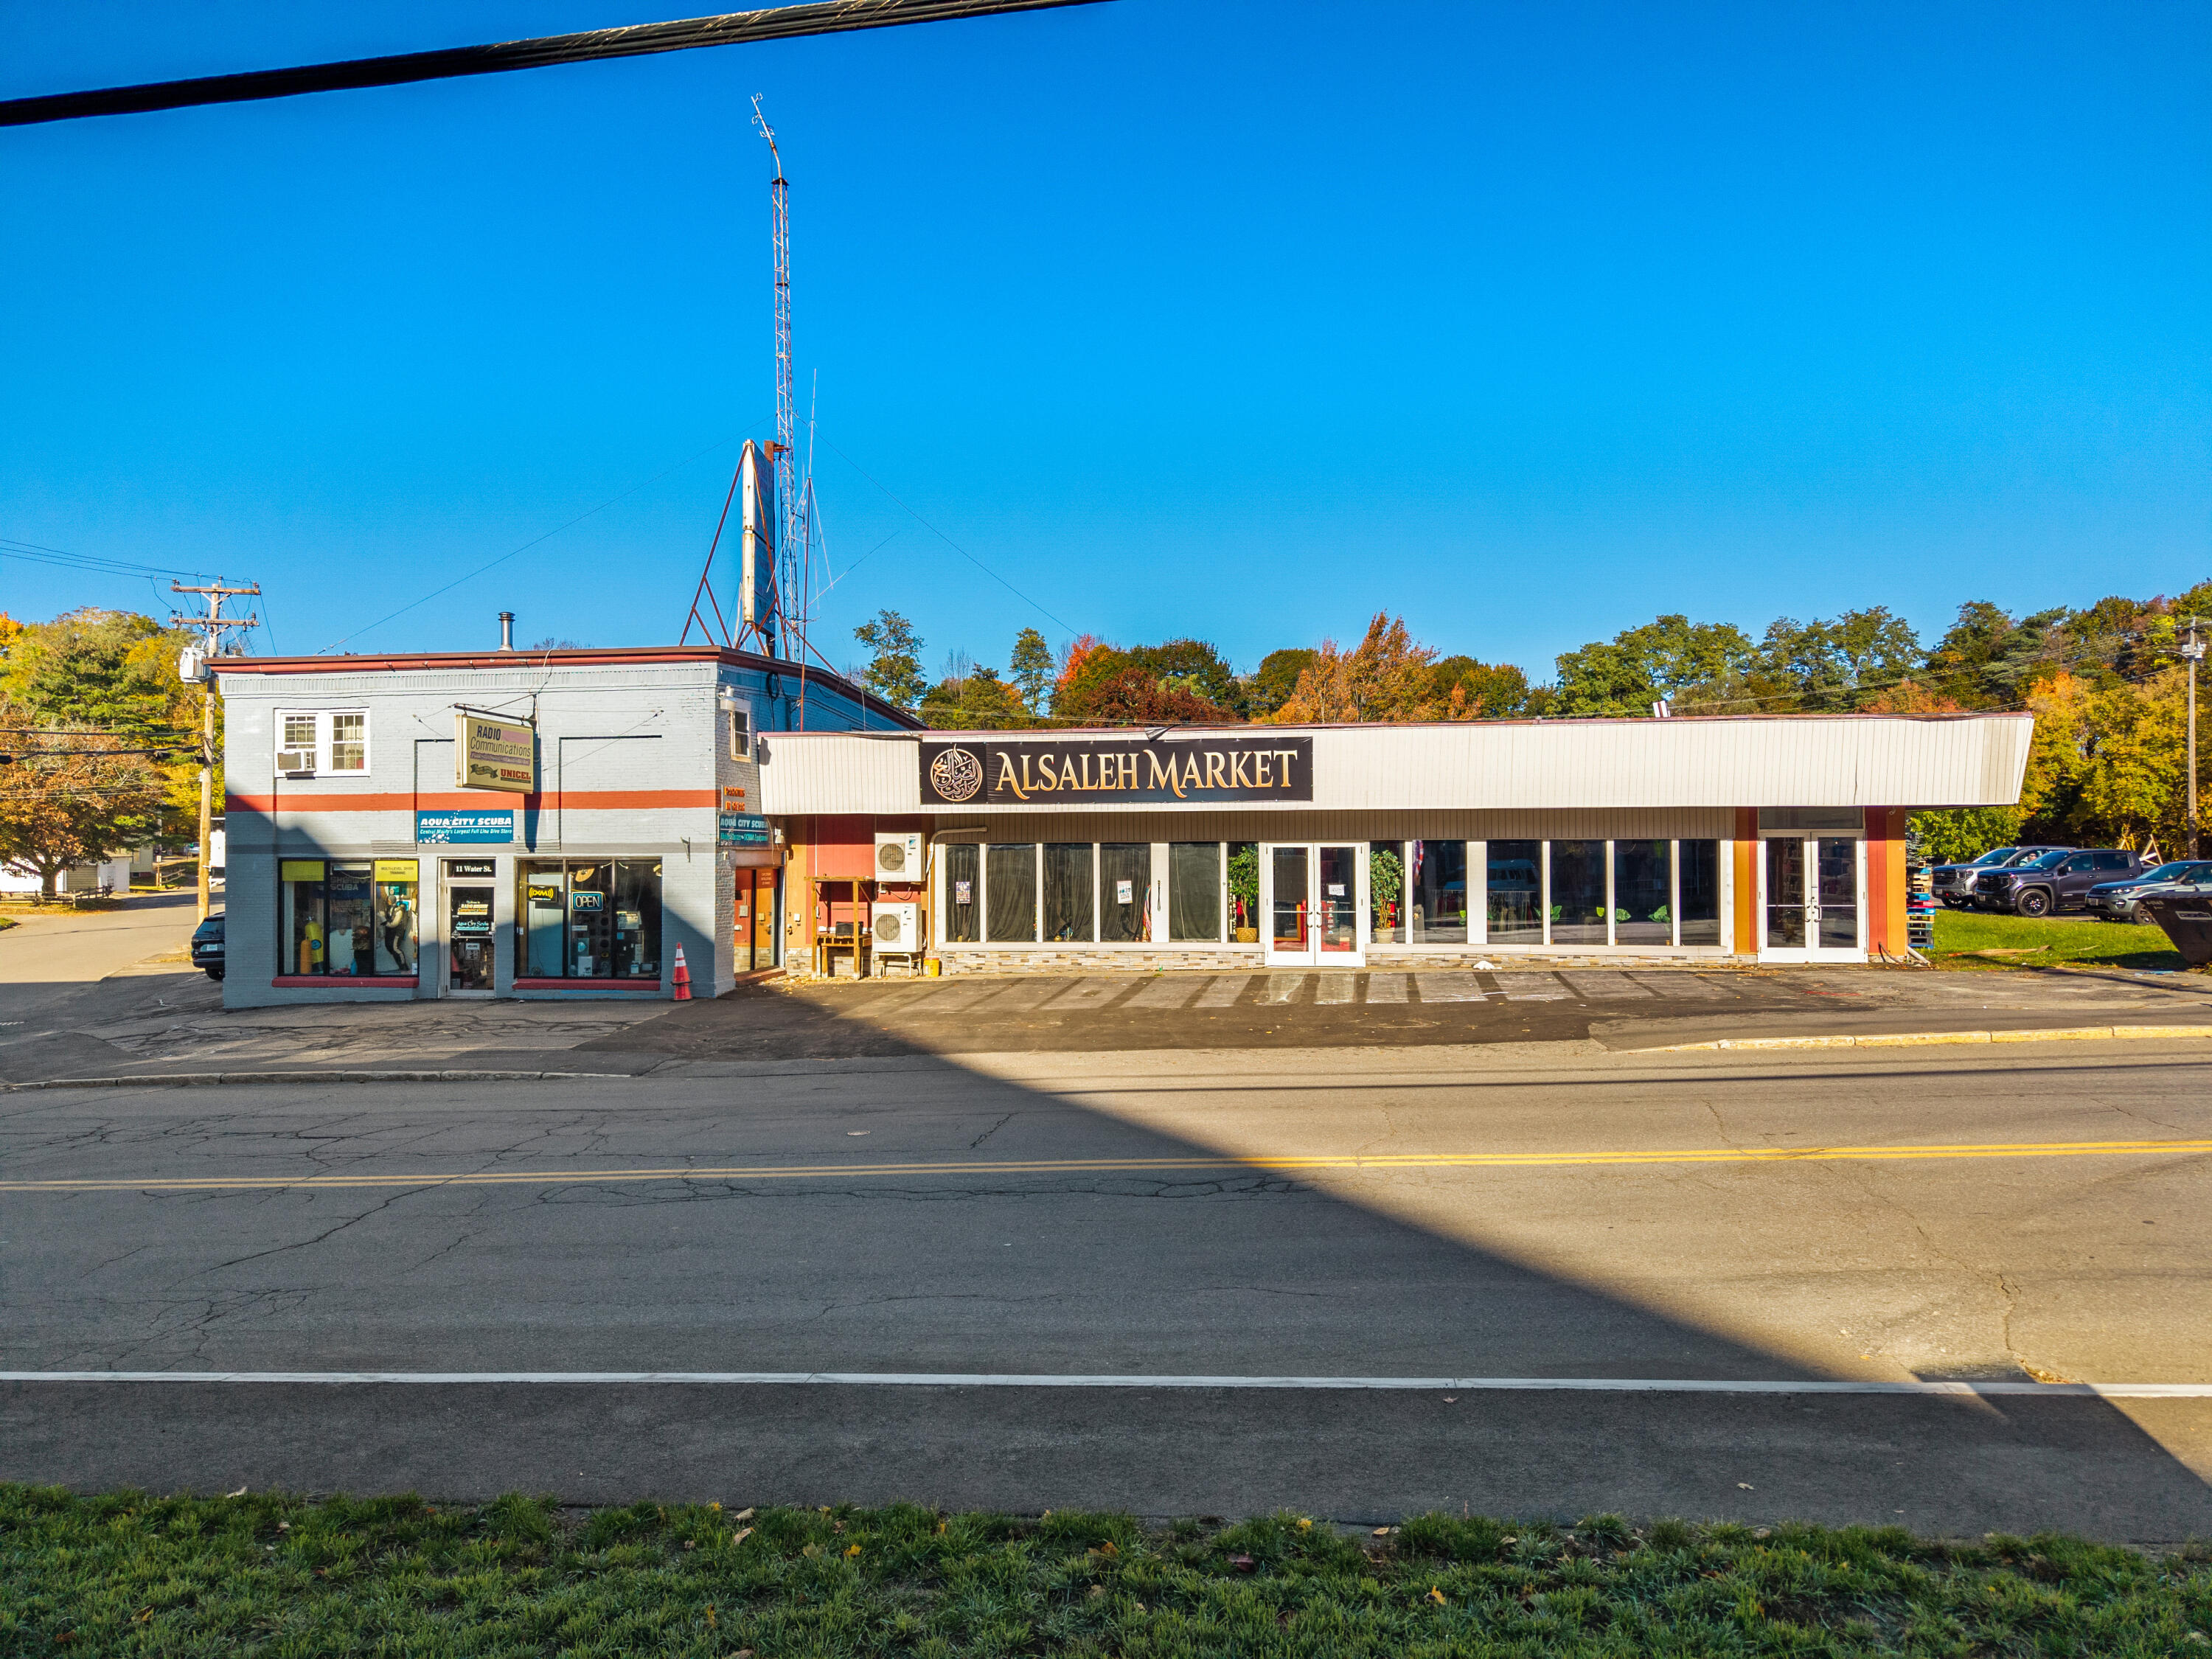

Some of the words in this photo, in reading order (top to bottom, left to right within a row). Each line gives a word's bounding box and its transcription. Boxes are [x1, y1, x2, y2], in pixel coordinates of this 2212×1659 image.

[477, 726, 501, 741] RADIO
[470, 737, 531, 757] Communications
[500, 768, 531, 779] UNICEL
[995, 751, 1139, 800] ALSALEH
[1144, 749, 1298, 799] MARKET
[420, 818, 450, 826] AQUA
[451, 817, 476, 826] CITY
[477, 817, 512, 826] SCUBA
[720, 818, 737, 827] AQUA
[737, 818, 751, 827] CITY
[575, 895, 600, 908] OPEN
